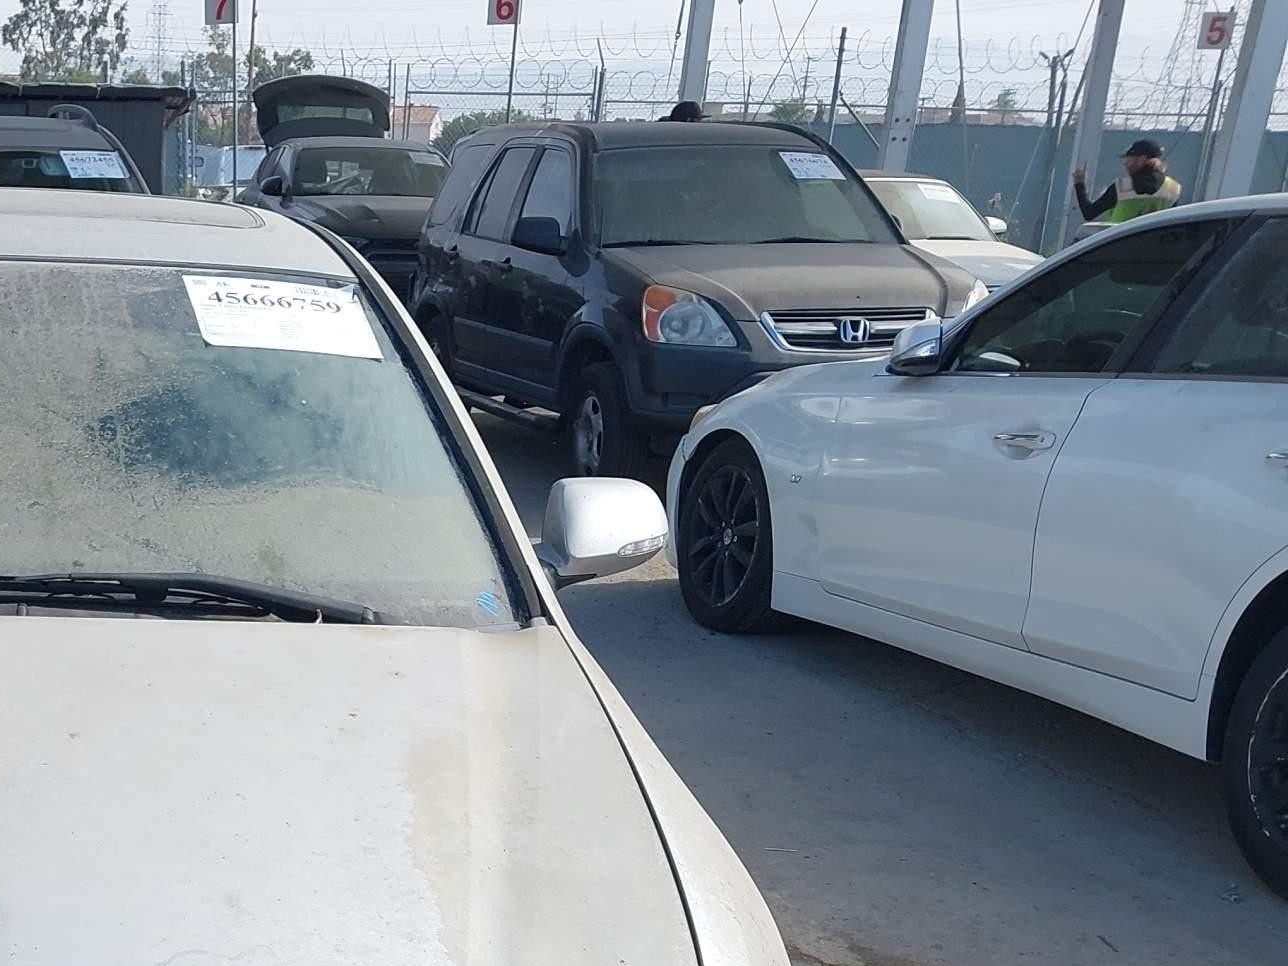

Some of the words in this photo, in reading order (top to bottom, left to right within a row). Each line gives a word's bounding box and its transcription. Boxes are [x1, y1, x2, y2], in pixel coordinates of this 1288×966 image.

[496, 0, 514, 20] 6
[1206, 16, 1228, 46] 5
[207, 291, 342, 314] 45666759
